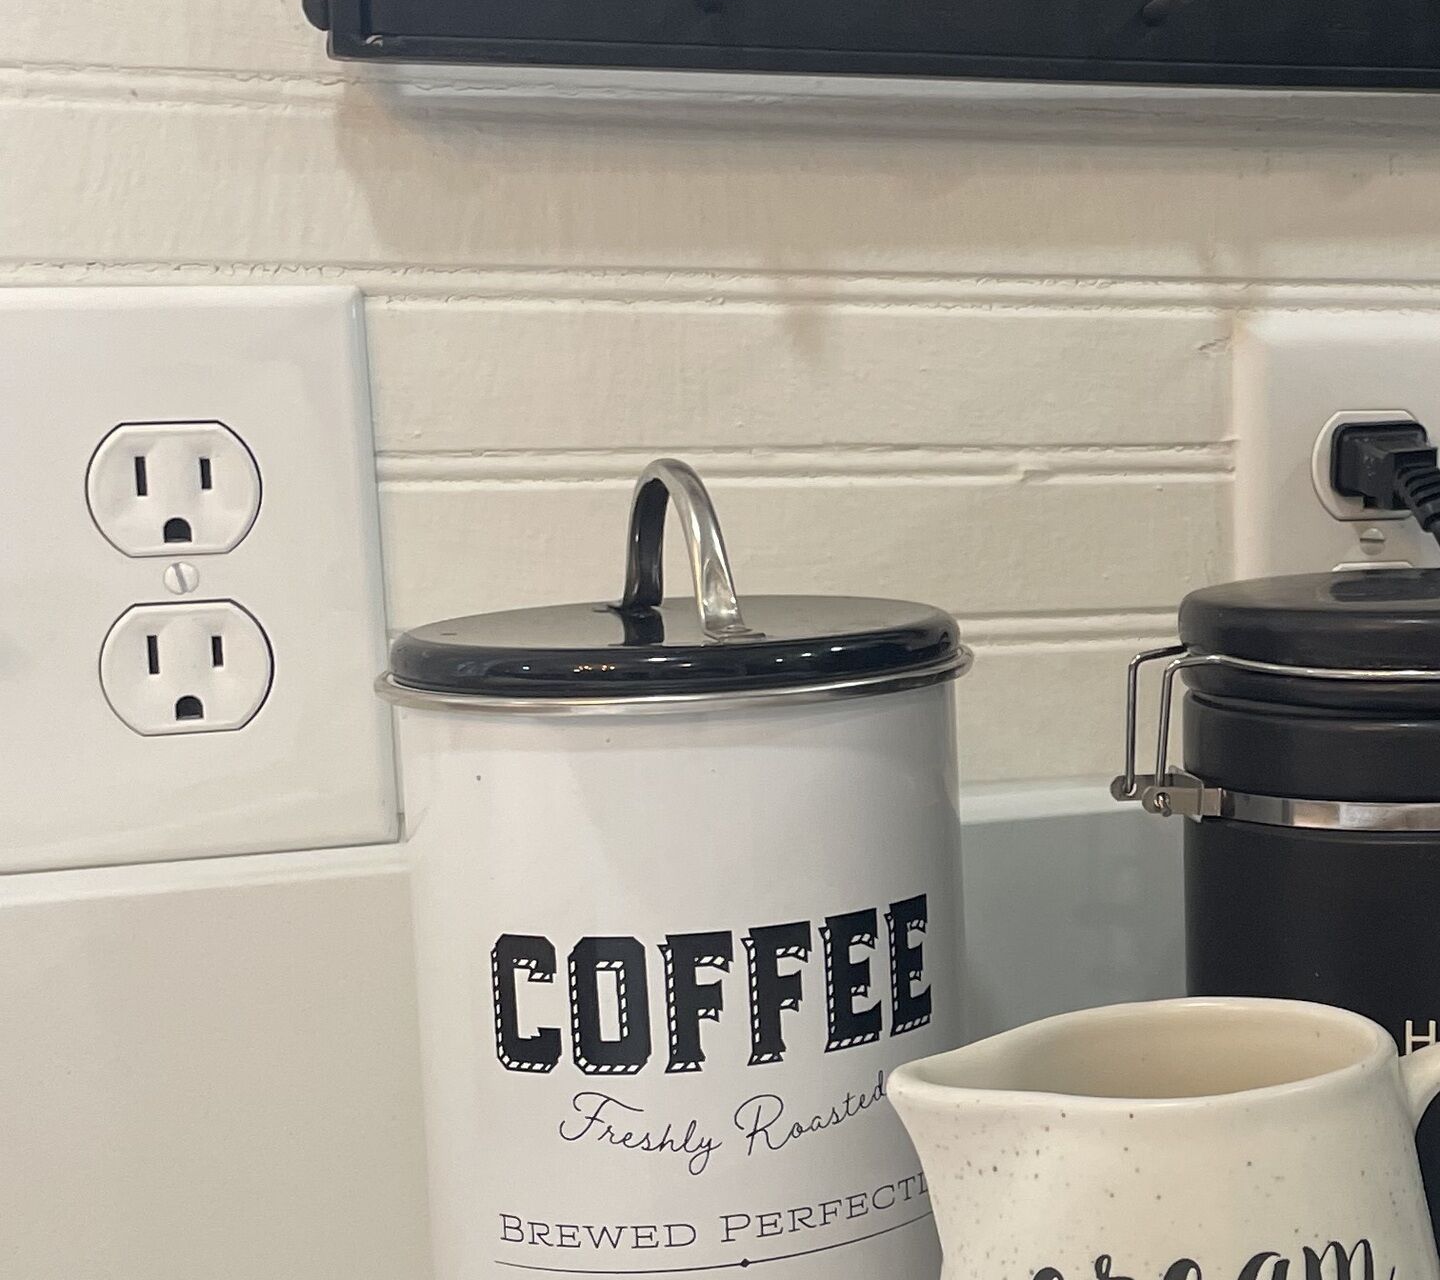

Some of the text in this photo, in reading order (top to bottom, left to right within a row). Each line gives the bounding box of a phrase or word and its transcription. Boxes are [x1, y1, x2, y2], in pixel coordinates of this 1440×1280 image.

[490, 893, 932, 1076] COFFEE
[559, 1070, 887, 1176] Freshly Roasted
[499, 1213, 697, 1250] BREWED
